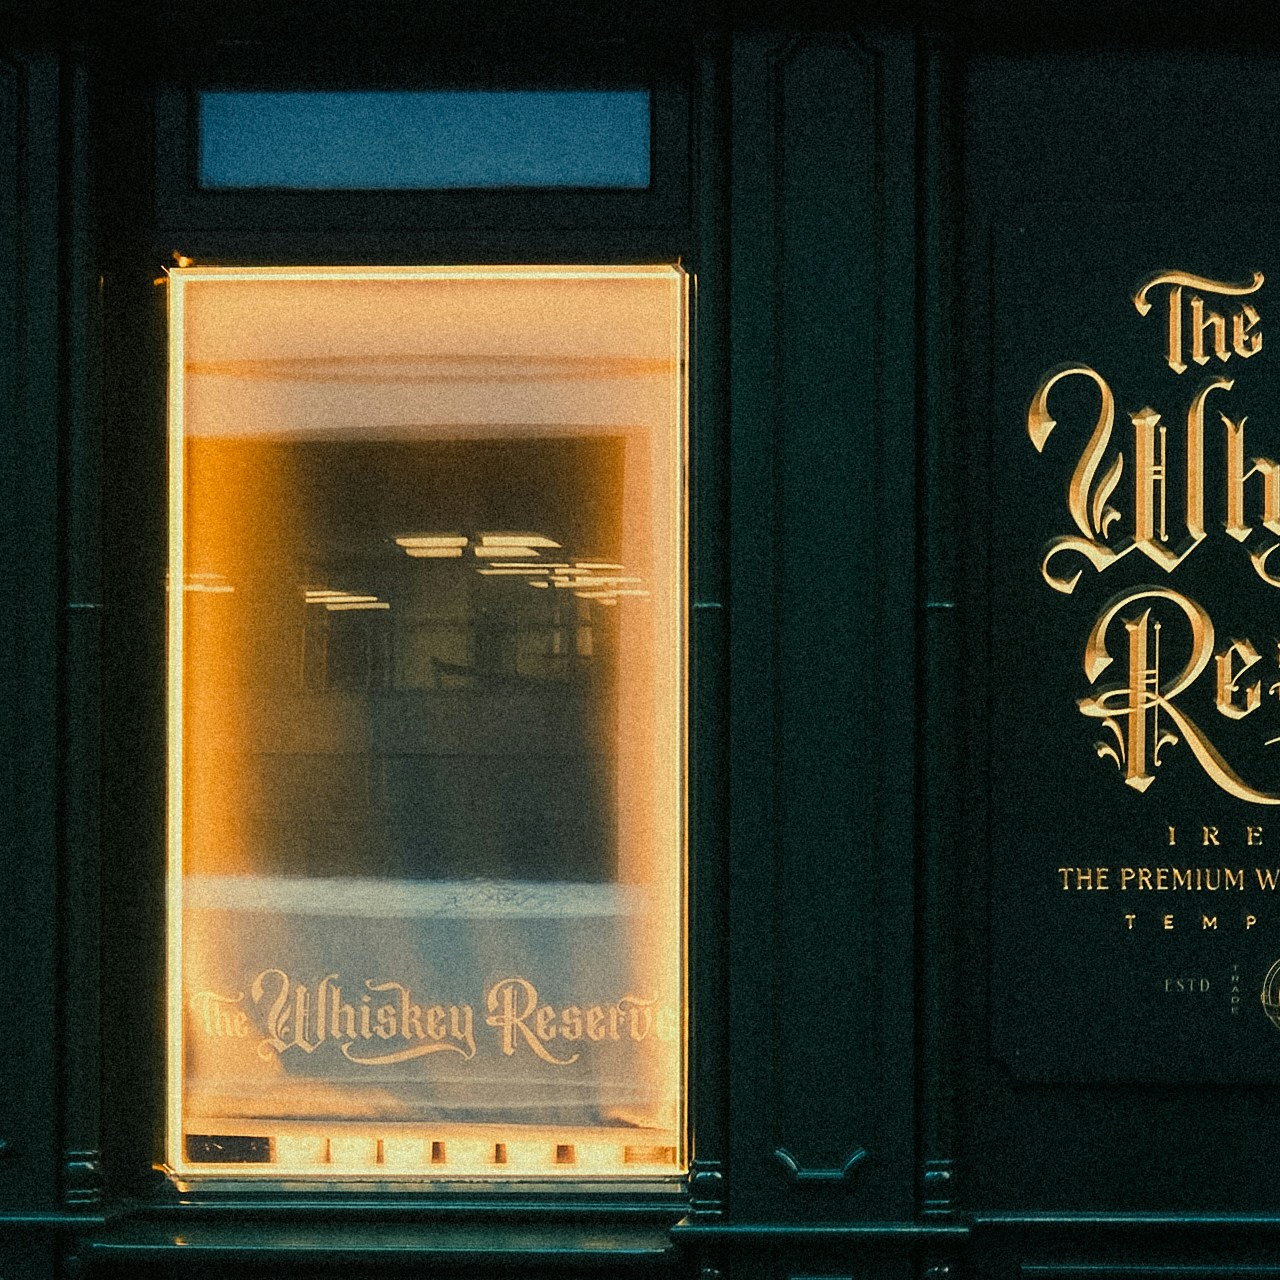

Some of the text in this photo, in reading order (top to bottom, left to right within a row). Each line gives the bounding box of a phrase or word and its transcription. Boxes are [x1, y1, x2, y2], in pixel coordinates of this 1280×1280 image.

[1135, 268, 1266, 375] The
[1058, 867, 1110, 891] THE
[1119, 867, 1245, 891] PREMIUM
[1163, 977, 1211, 993] ESTD
[194, 990, 250, 1040] The
[250, 968, 477, 1066] Whiskey
